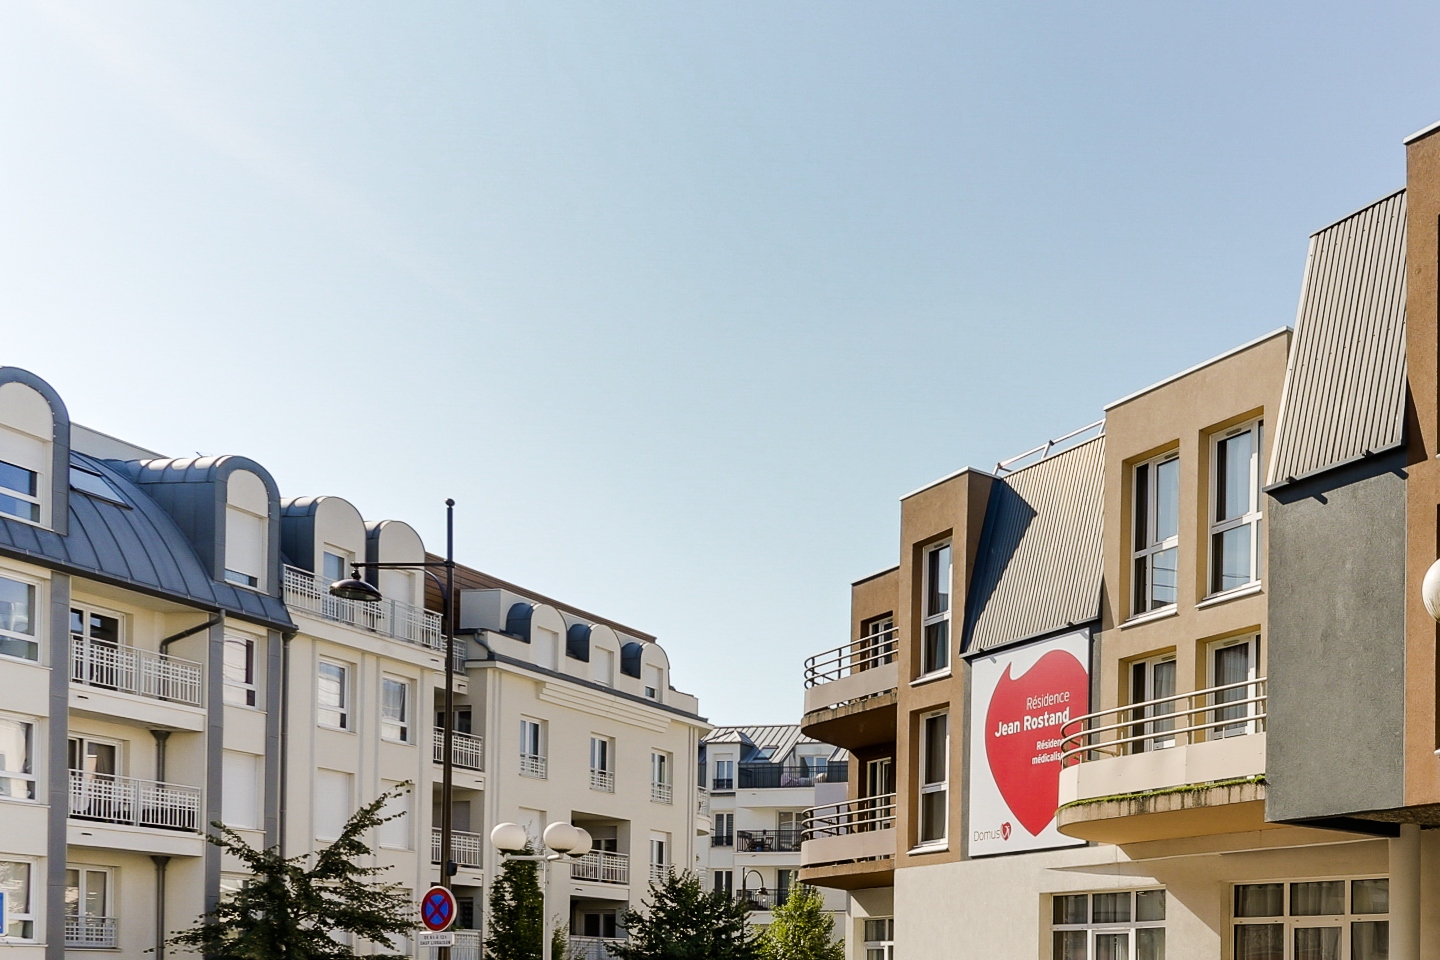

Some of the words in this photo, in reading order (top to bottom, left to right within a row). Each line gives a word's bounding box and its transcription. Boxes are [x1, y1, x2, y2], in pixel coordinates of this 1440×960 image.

[1026, 691, 1070, 710] Résidence
[994, 720, 1020, 738] Jean
[1024, 707, 1070, 731] Rostand
[1036, 738, 1065, 751] Résiden
